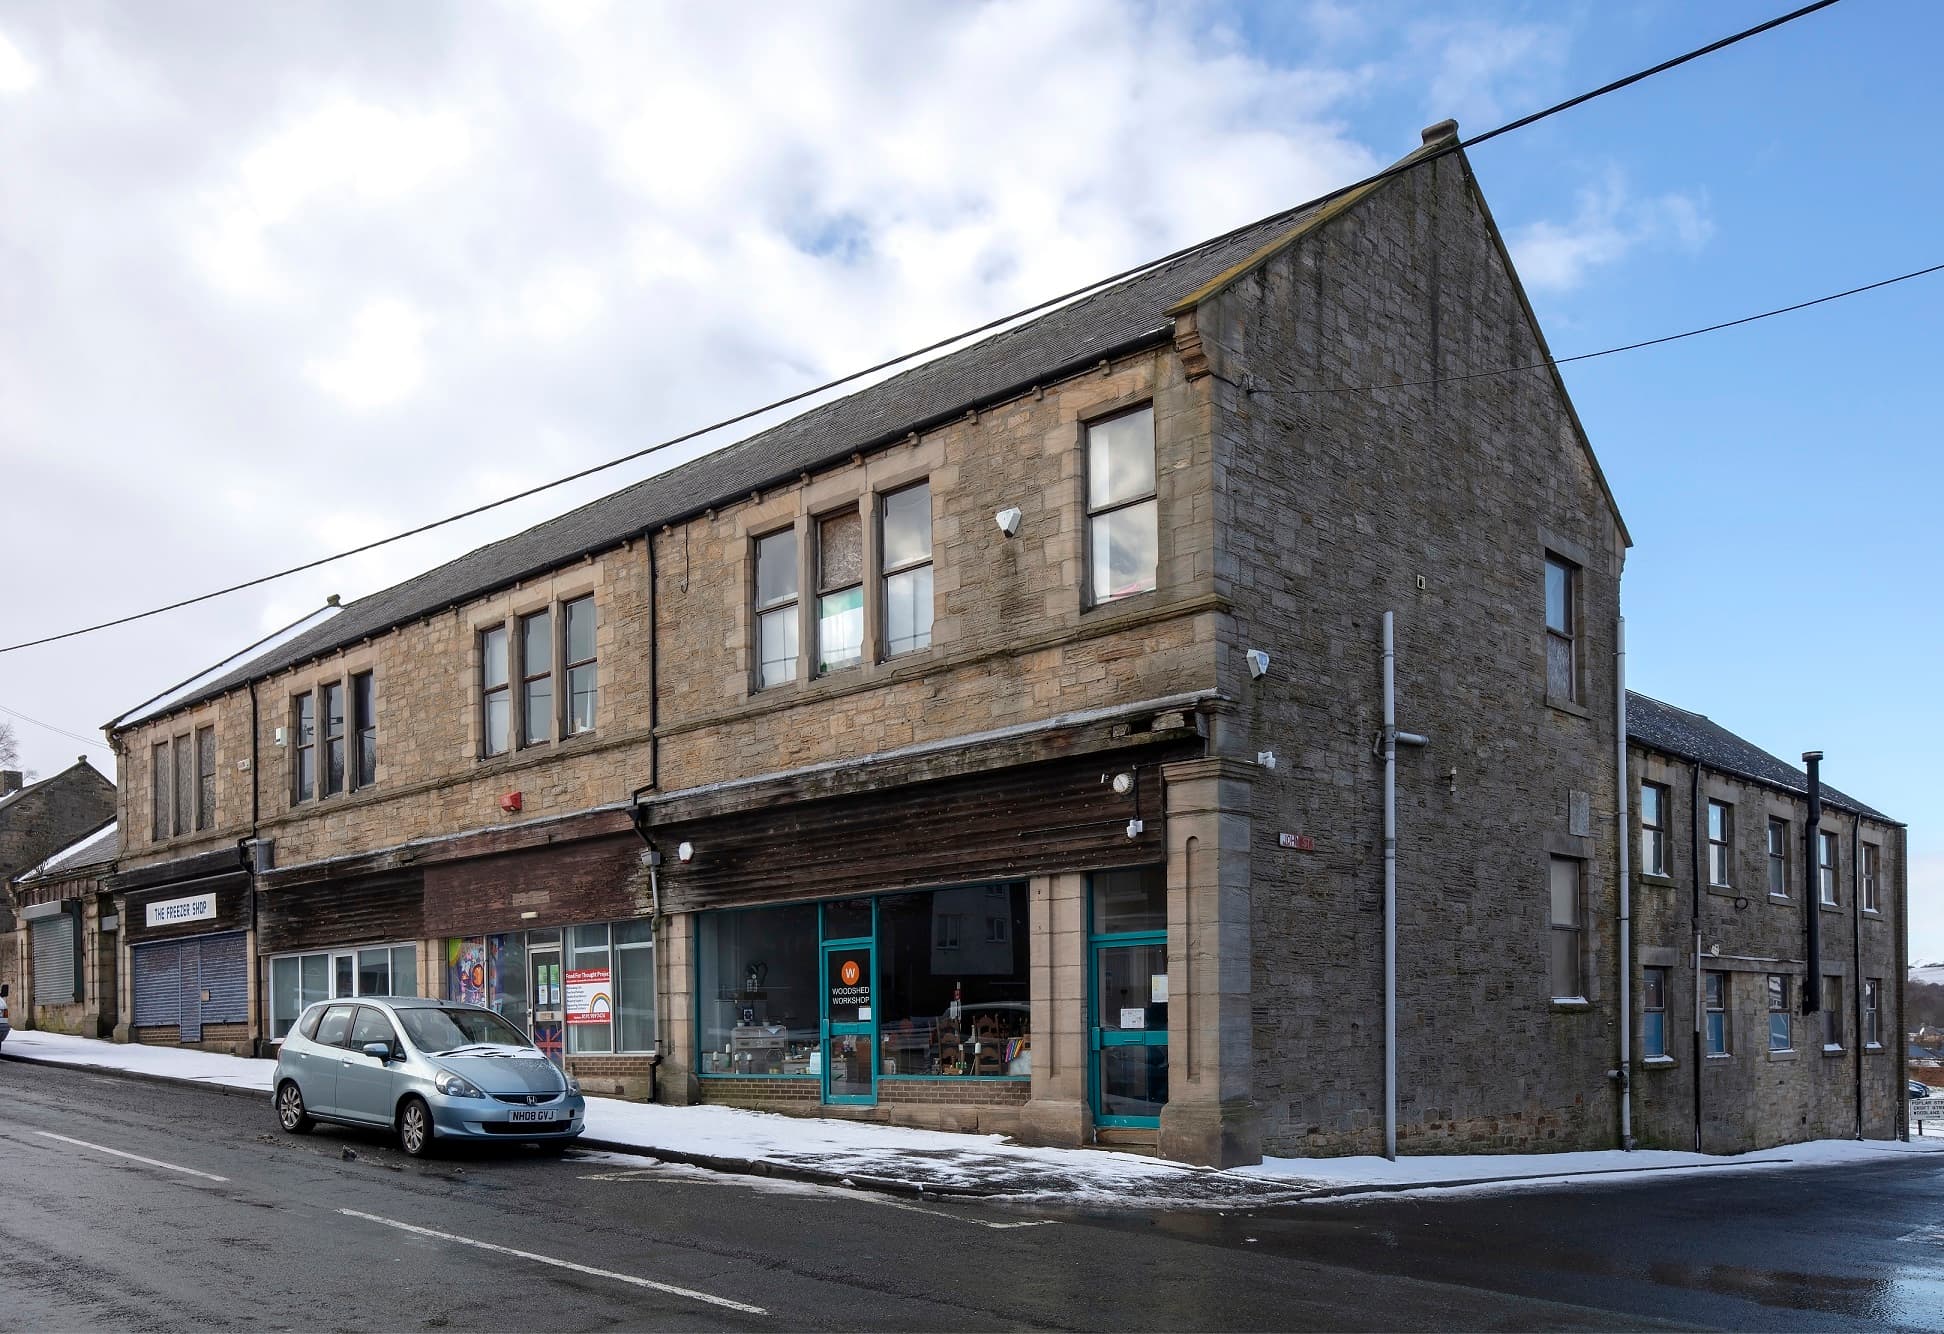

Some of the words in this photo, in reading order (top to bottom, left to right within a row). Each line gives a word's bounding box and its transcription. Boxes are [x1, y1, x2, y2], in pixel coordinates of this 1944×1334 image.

[155, 907, 165, 920] THE
[167, 903, 190, 919] FREEZER
[192, 900, 207, 915] SHOP
[845, 967, 856, 979] W
[831, 986, 870, 995] WOODSHED
[833, 996, 869, 1005] WORKSHOP
[513, 1111, 536, 1121] NH08
[537, 1111, 554, 1120] GVJ
